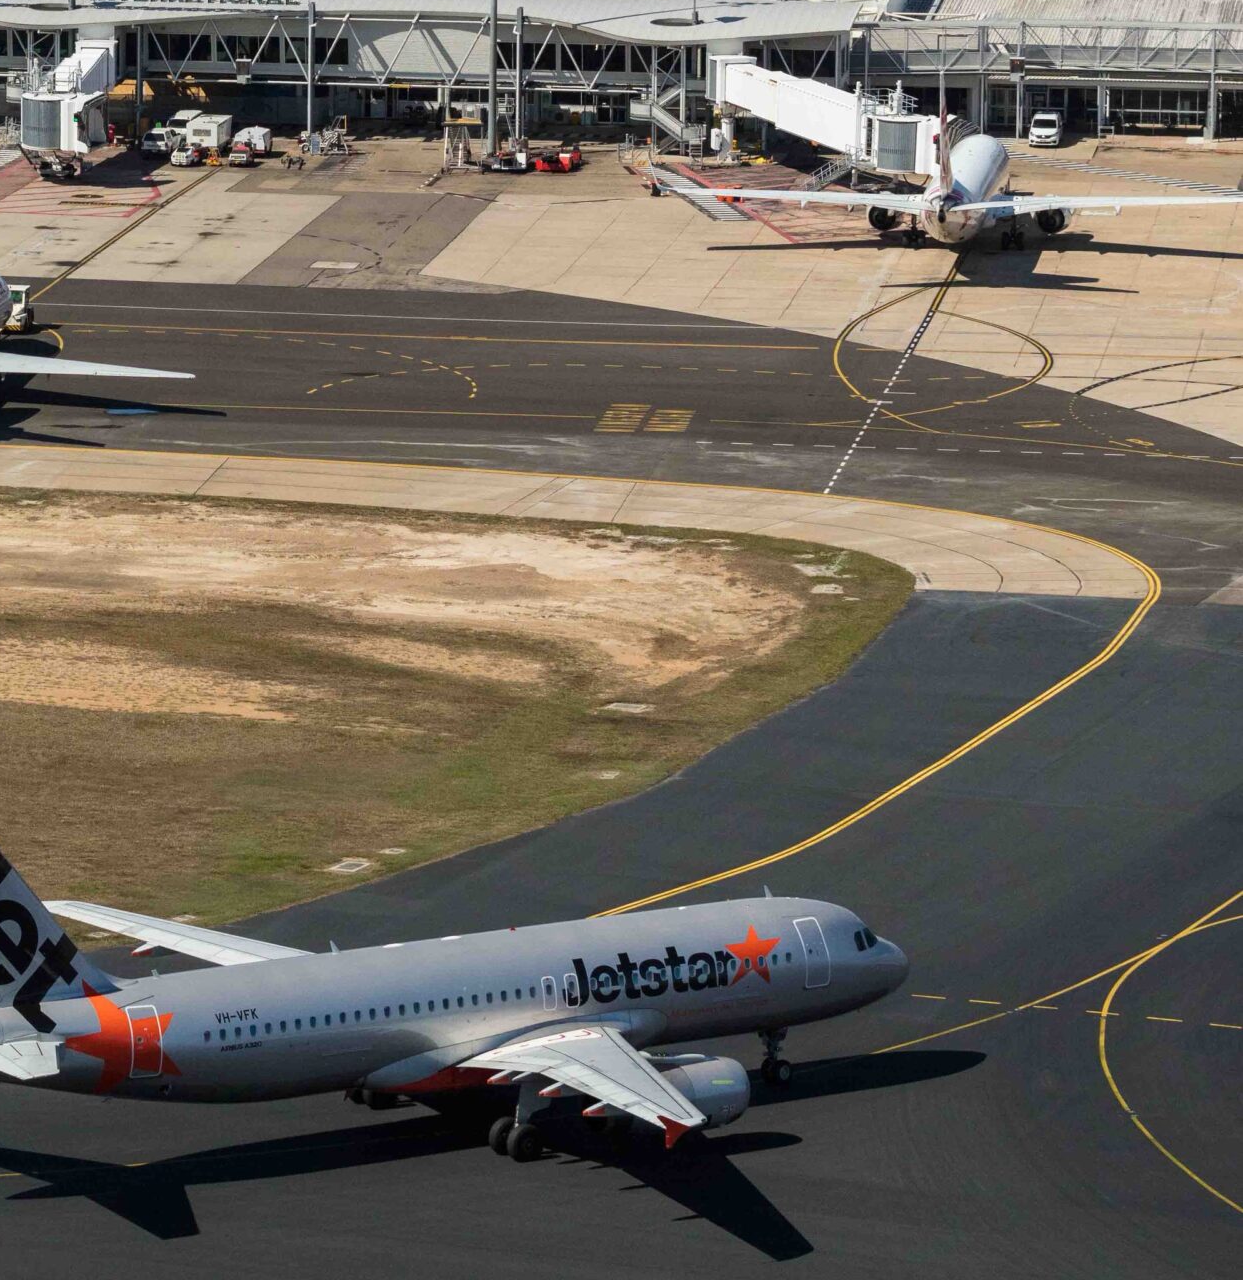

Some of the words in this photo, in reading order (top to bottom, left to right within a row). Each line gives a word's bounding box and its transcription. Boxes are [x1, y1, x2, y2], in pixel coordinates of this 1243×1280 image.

[562, 946, 737, 1007] Jetstar
[215, 1008, 259, 1024] VH-VFK
[244, 1040, 263, 1049] A320
